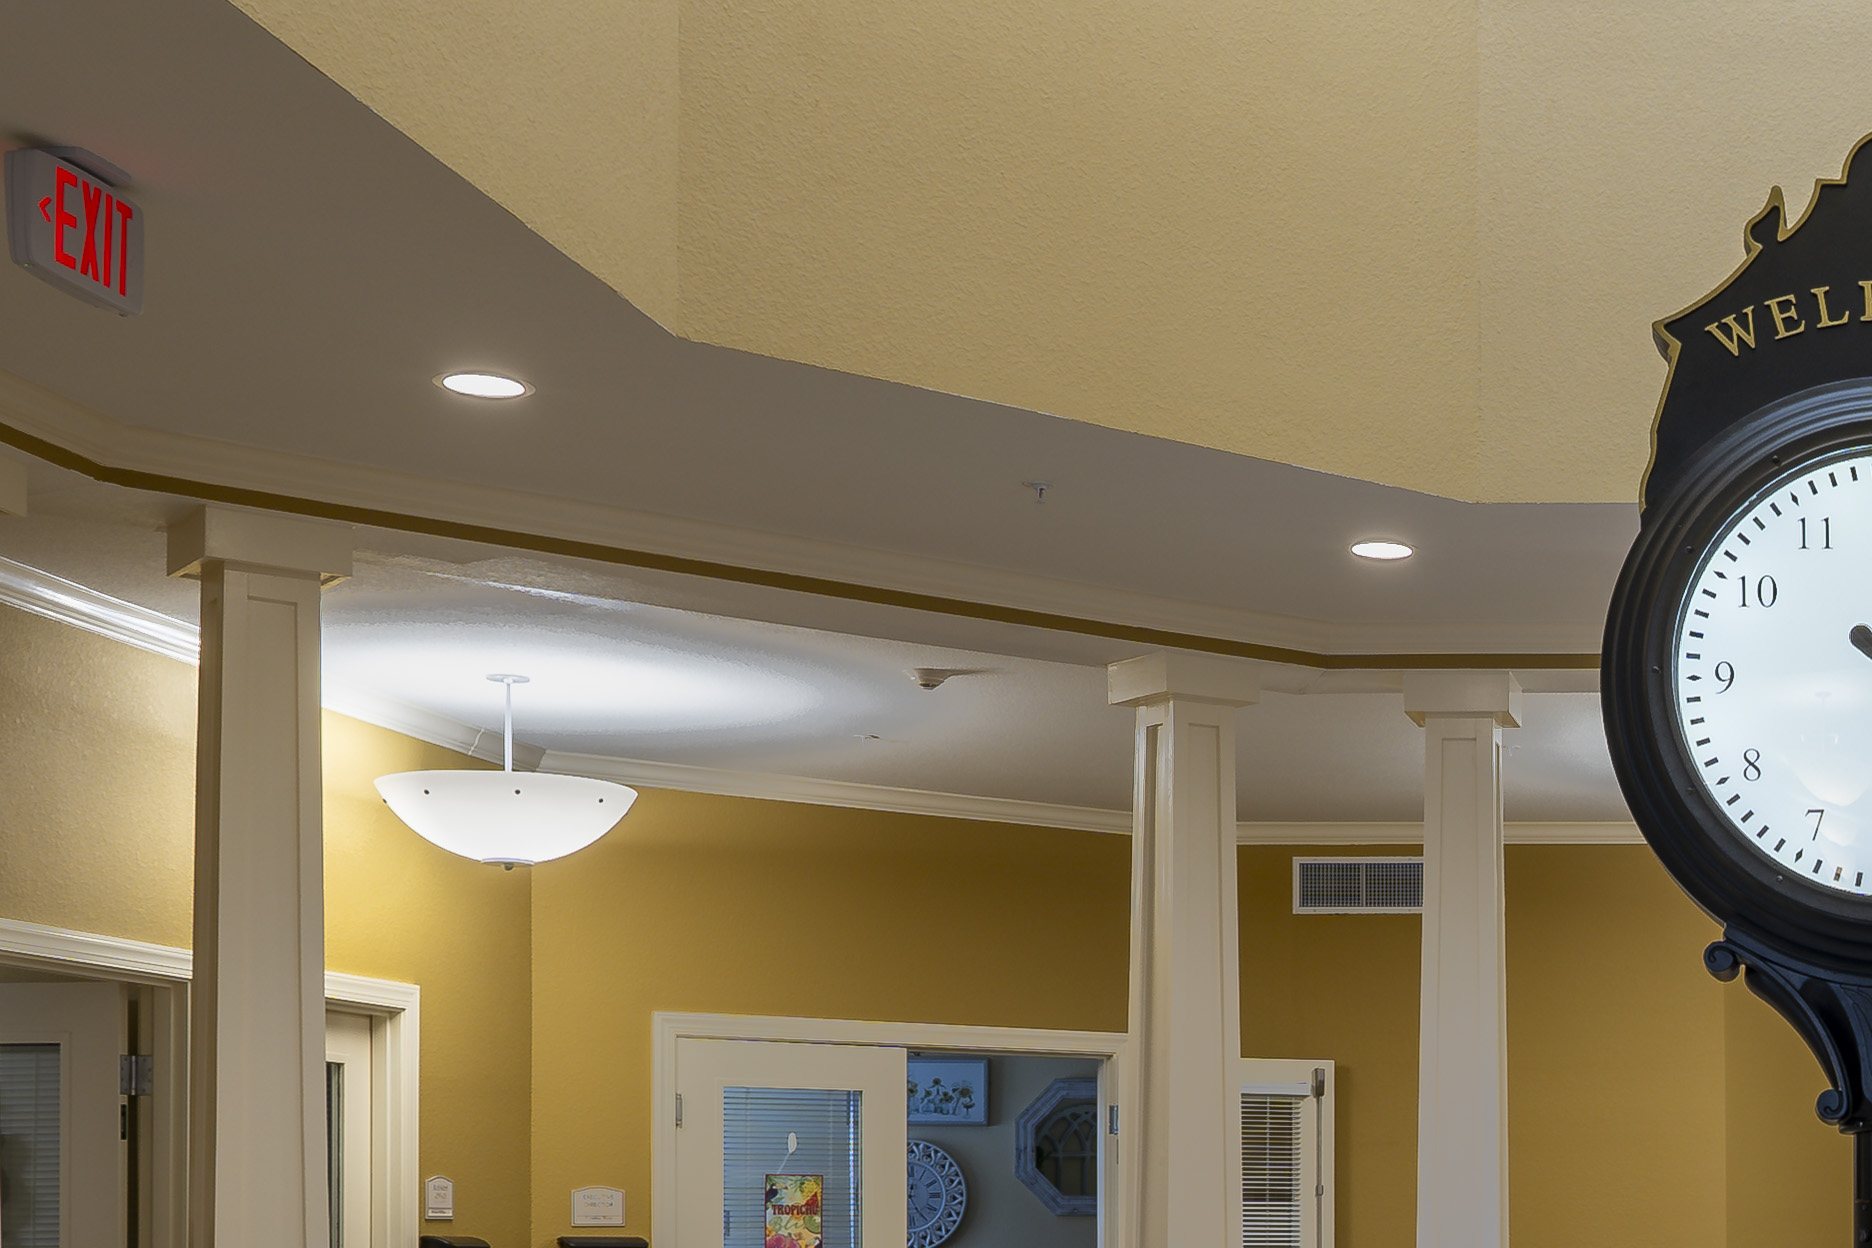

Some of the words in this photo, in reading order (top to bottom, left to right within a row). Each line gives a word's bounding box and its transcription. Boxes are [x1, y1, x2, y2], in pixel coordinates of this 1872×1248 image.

[55, 166, 133, 297] EXIT
[1796, 517, 1834, 550] 11
[1737, 575, 1778, 608] 10
[1714, 661, 1735, 694] 9
[1743, 749, 1762, 781] 8
[1805, 808, 1825, 841] 7
[771, 1204, 818, 1216] TROPICAL
